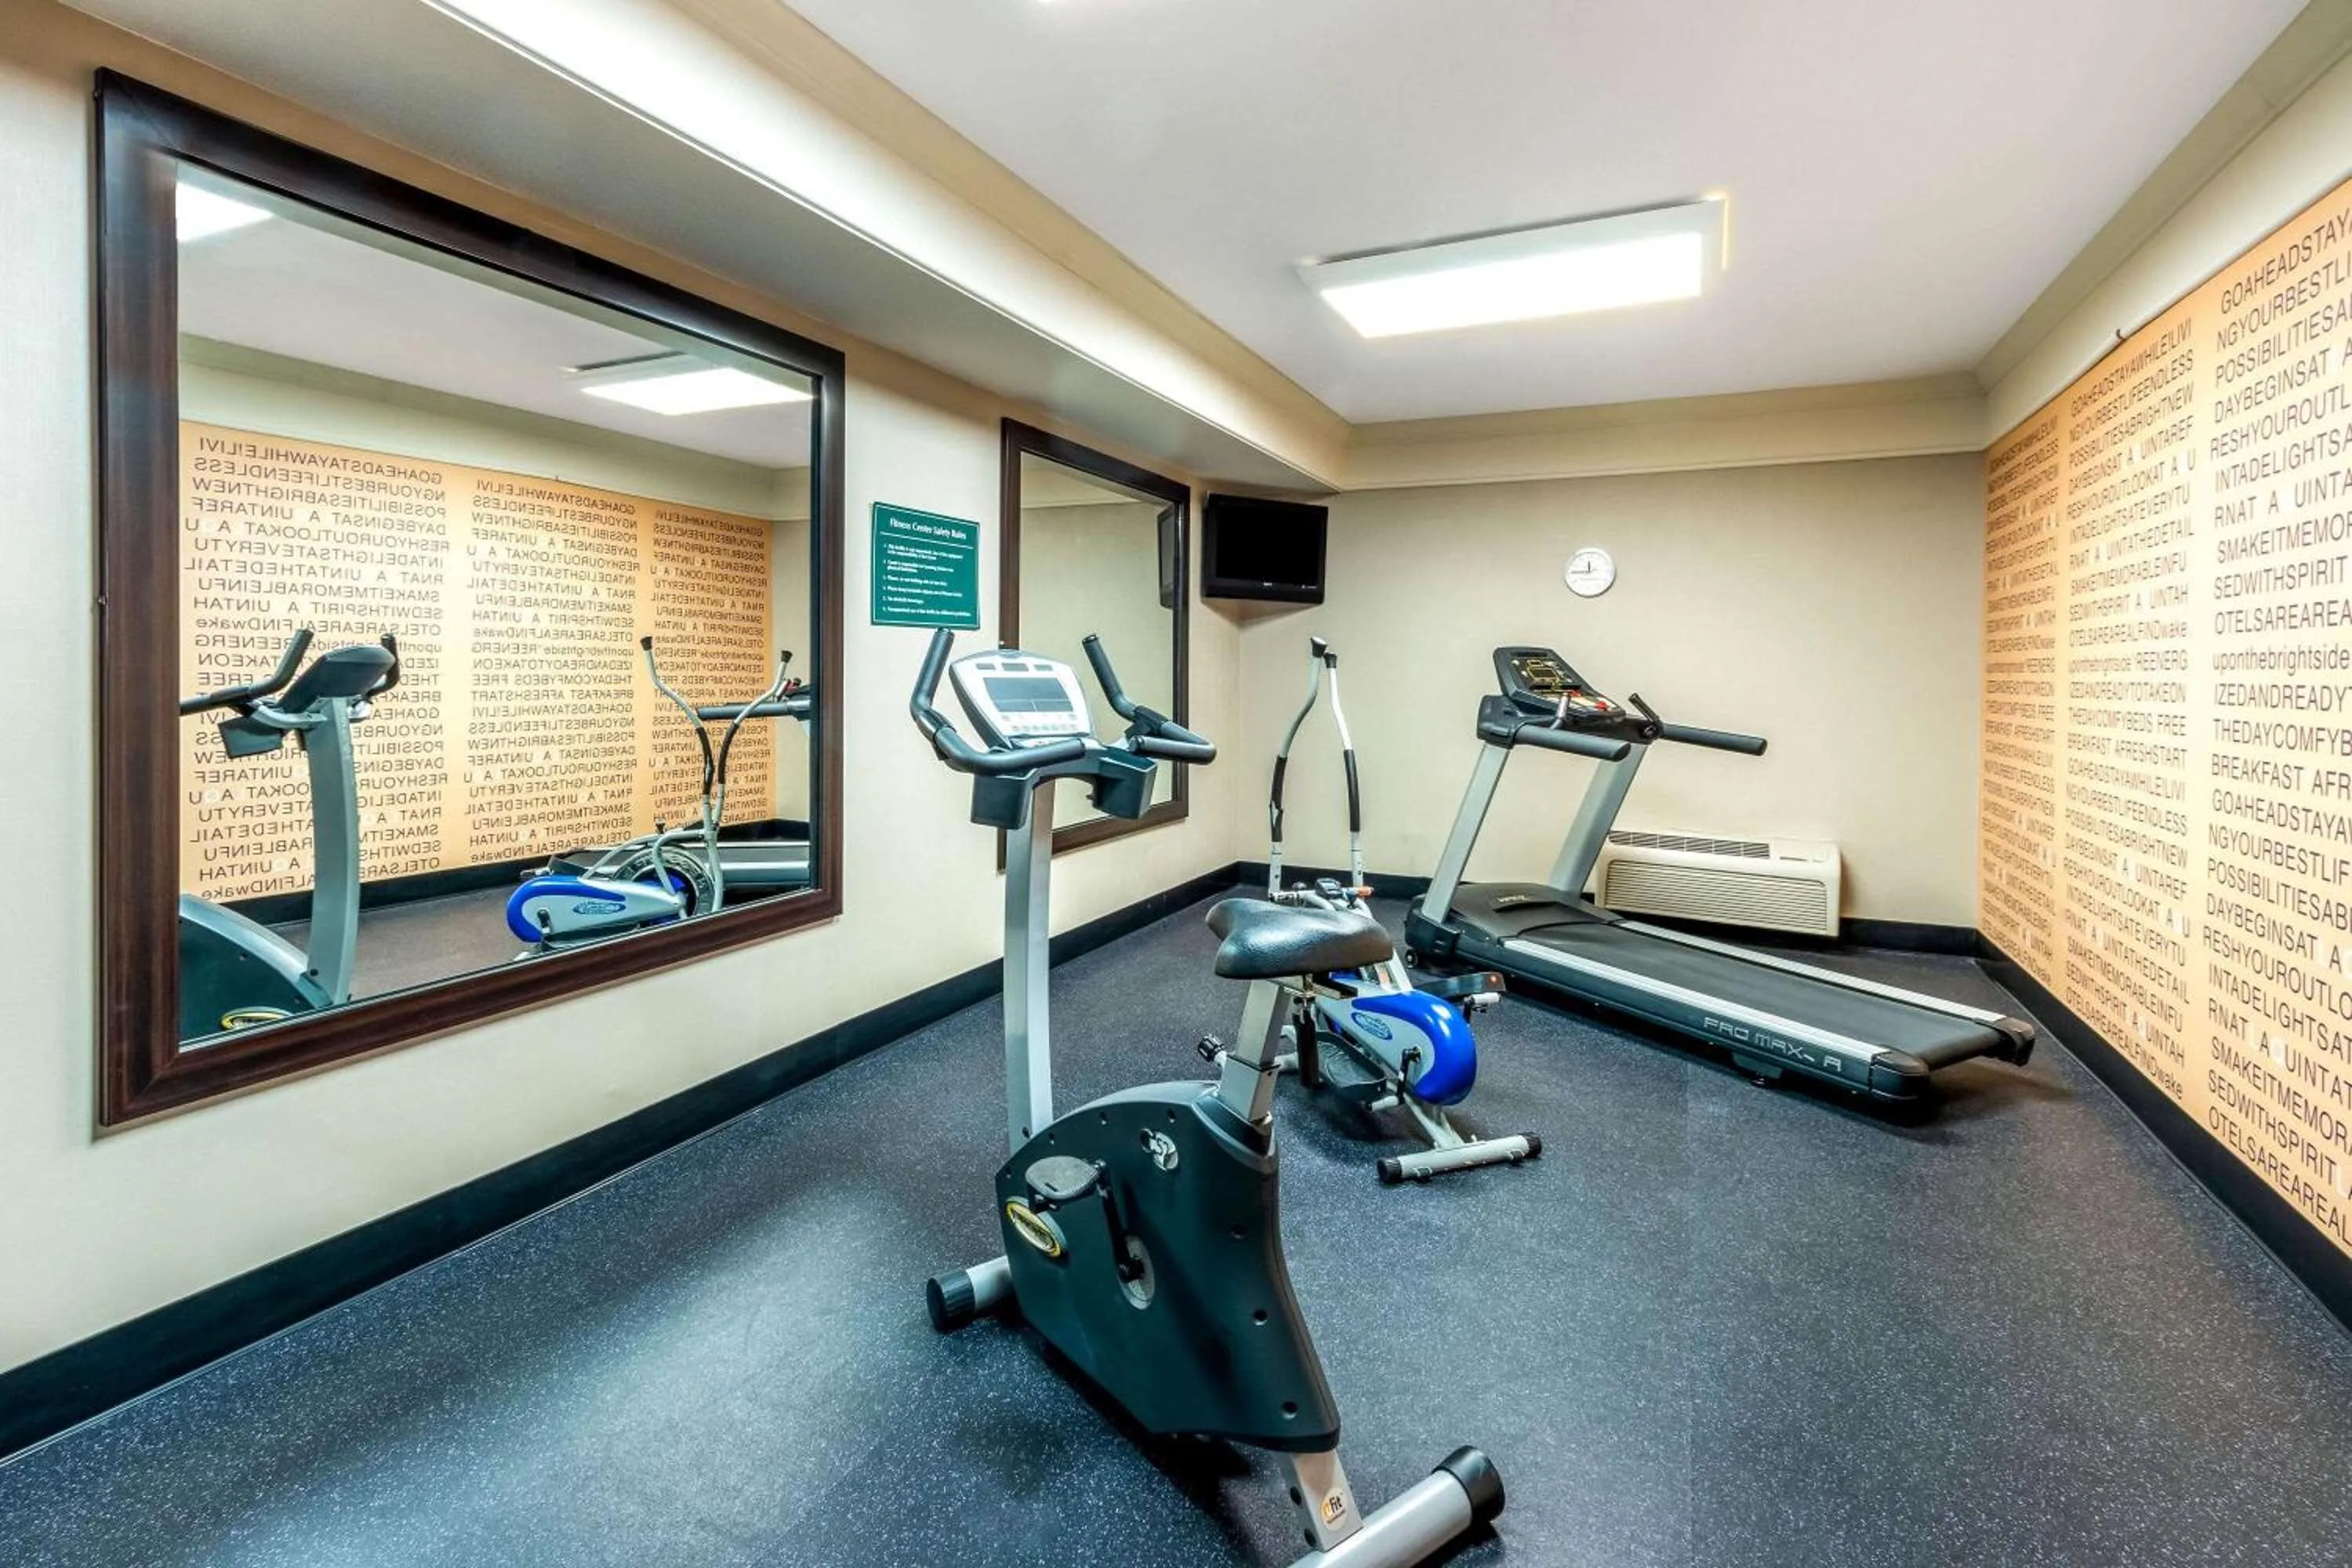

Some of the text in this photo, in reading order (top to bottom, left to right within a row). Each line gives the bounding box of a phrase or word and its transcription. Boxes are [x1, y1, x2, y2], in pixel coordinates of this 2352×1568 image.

[2216, 292, 2352, 389] POSSIBILITIESA
[913, 522, 932, 534] Center
[2212, 750, 2307, 796] BREAKFAST
[2212, 786, 2352, 850] GOAHEADSTAYA
[2207, 854, 2352, 938] POSSIBILITIESAB
[1704, 1017, 1750, 1040] PRO
[2212, 1032, 2352, 1161] SMAKEITMEMOR
